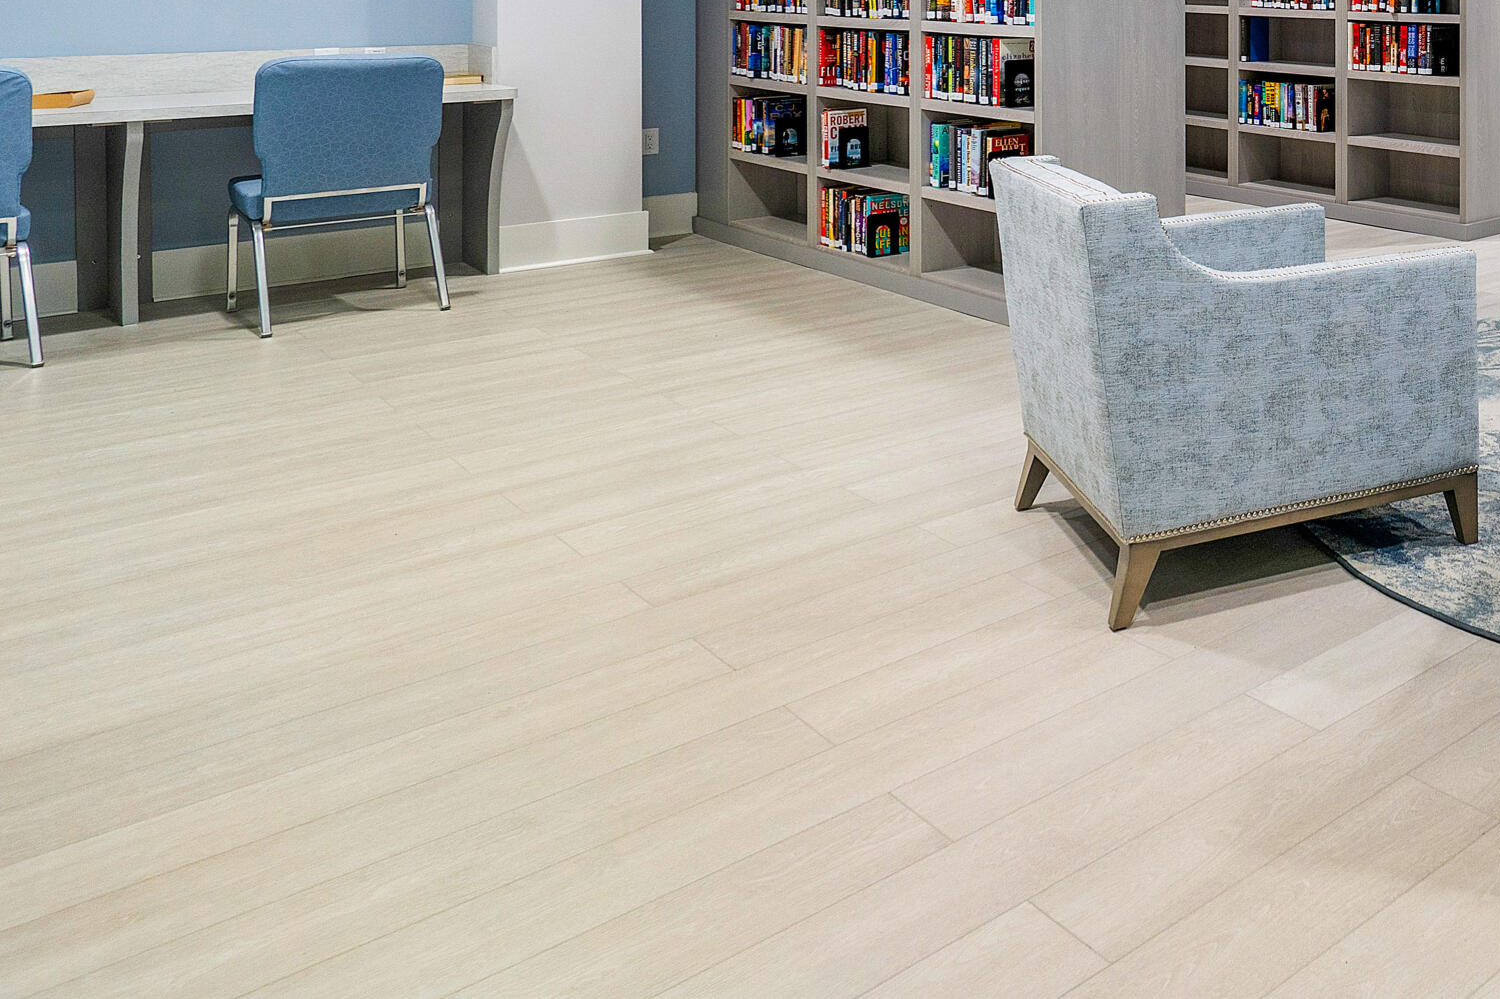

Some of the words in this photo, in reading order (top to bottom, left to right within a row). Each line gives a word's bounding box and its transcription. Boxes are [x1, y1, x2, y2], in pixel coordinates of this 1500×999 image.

[830, 115, 865, 126] ROBERT
[995, 137, 1019, 147] ELLEN
[871, 196, 909, 211] NELSON
